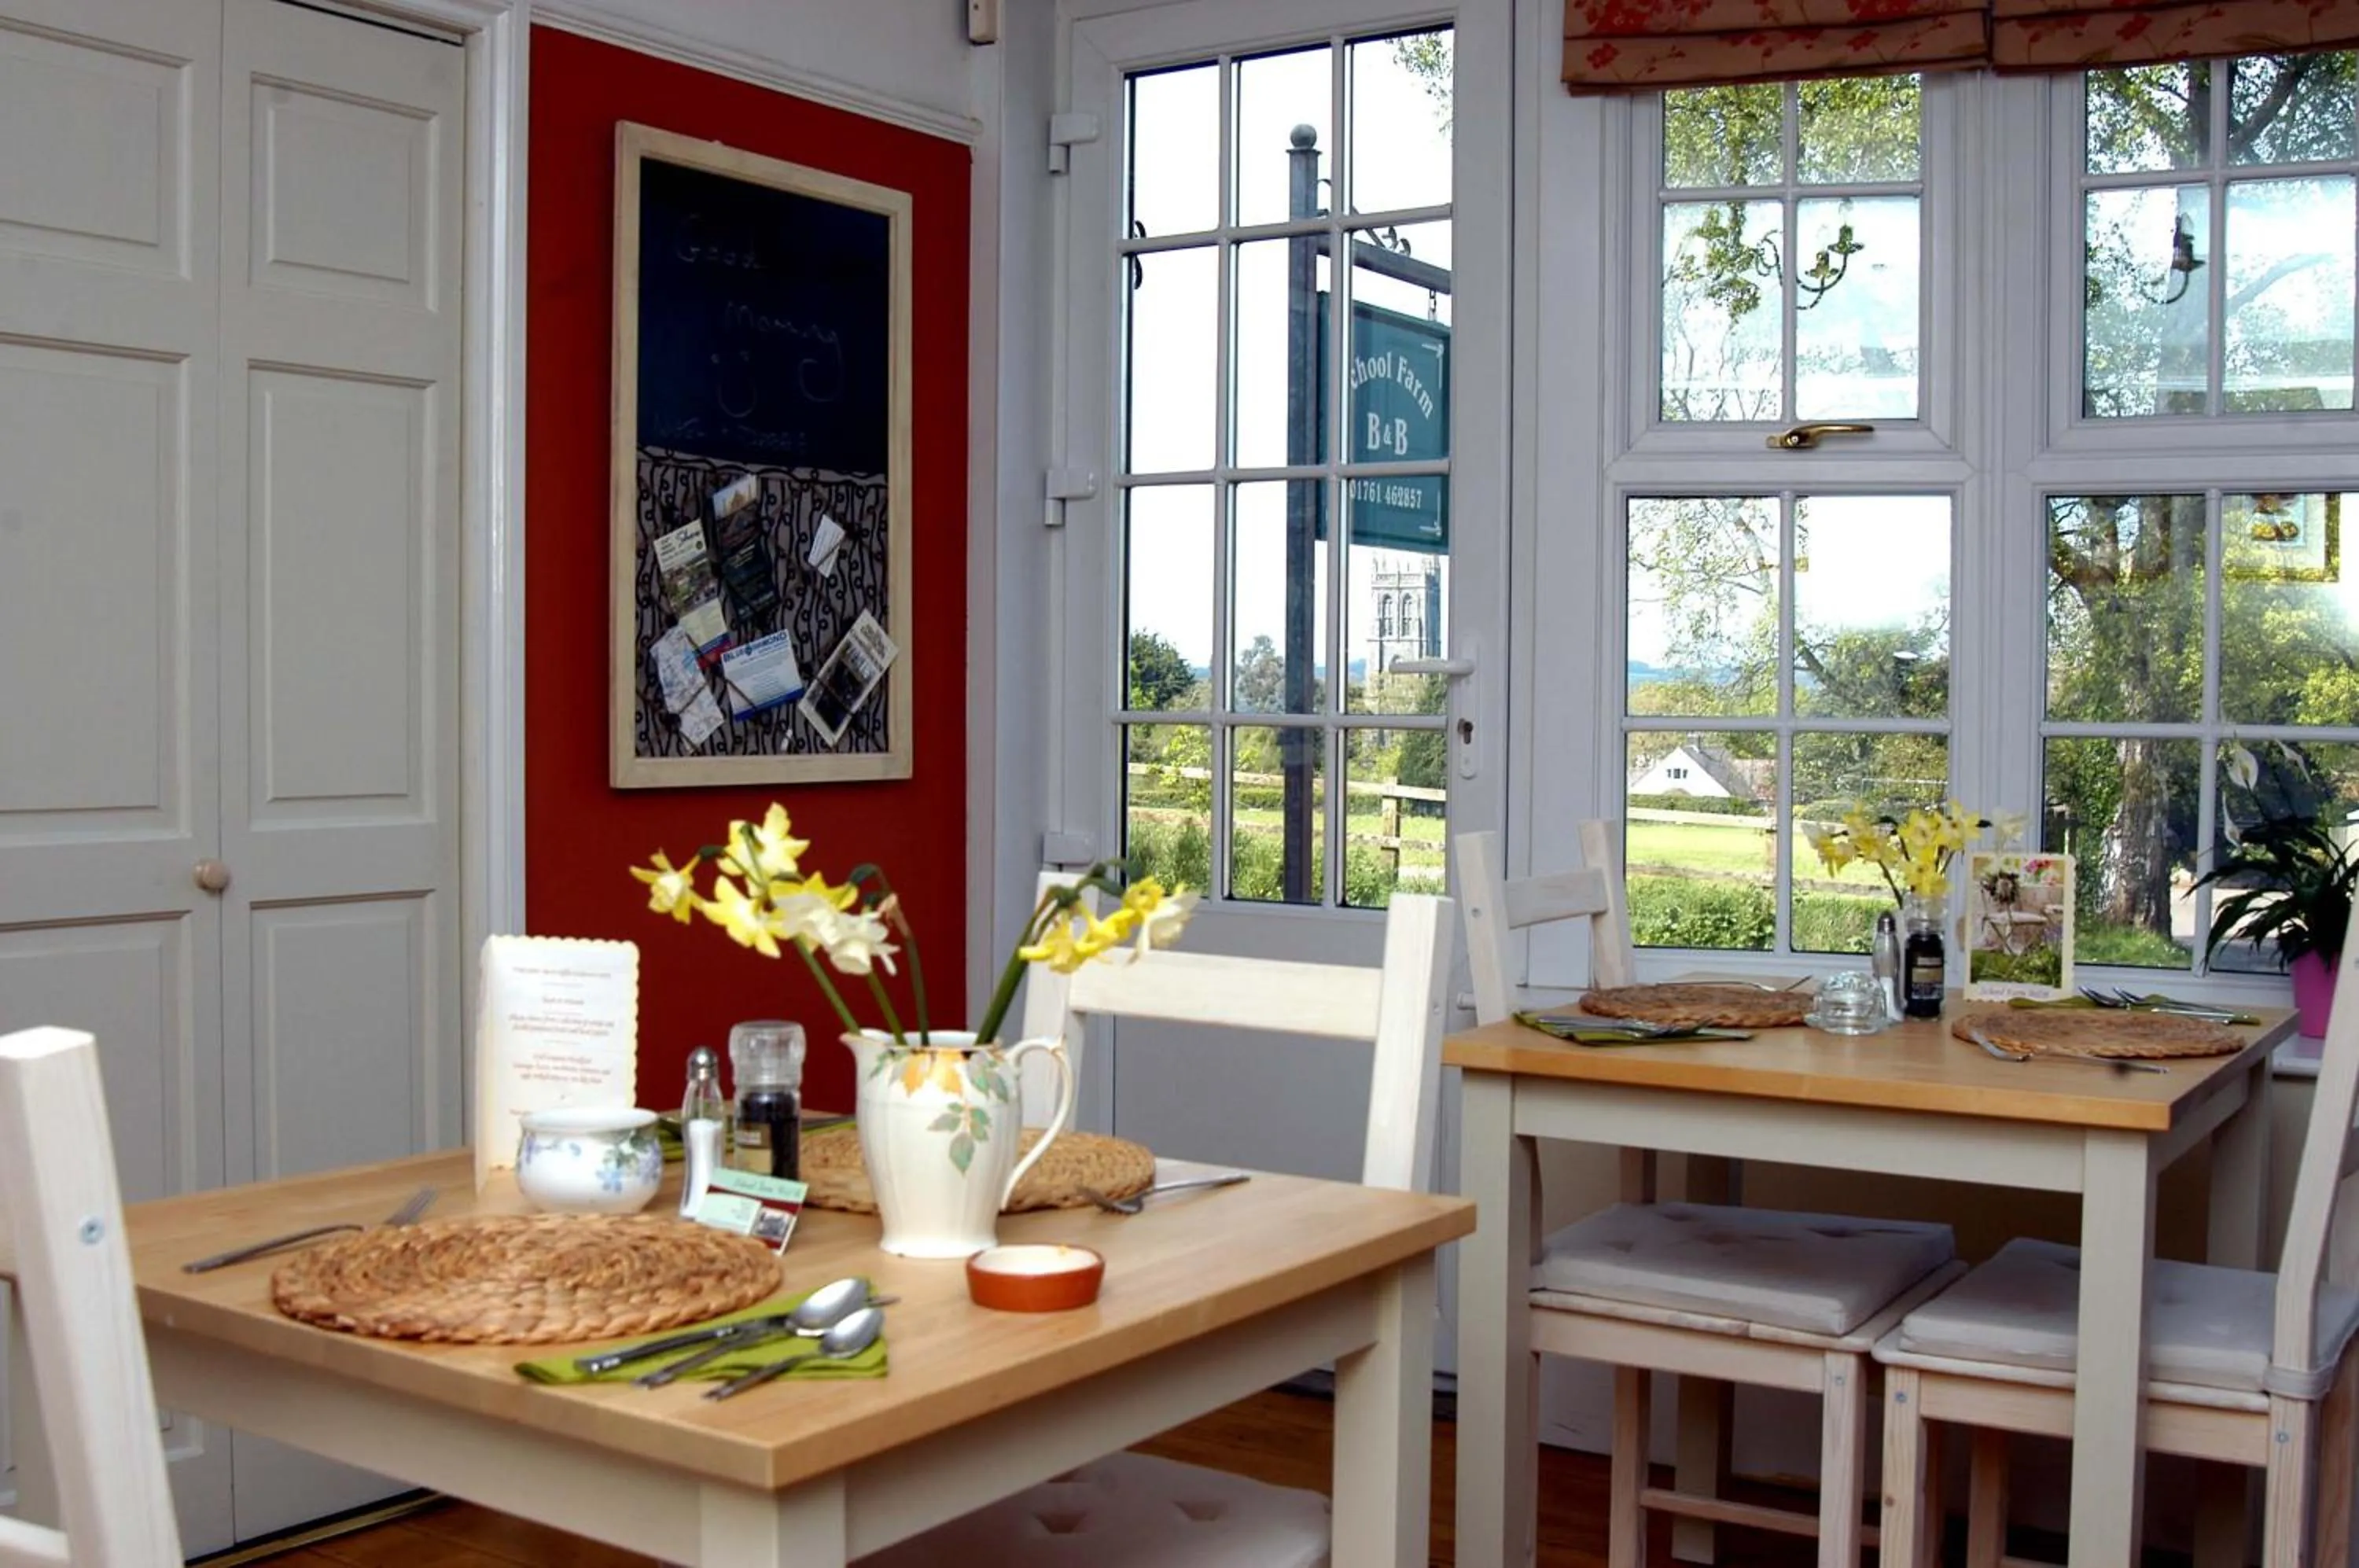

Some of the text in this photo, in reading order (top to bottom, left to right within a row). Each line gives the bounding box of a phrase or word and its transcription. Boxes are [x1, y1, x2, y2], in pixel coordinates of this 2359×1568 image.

[1350, 351, 1434, 421] chool Farm
[1349, 478, 1422, 510] 01761 462857
